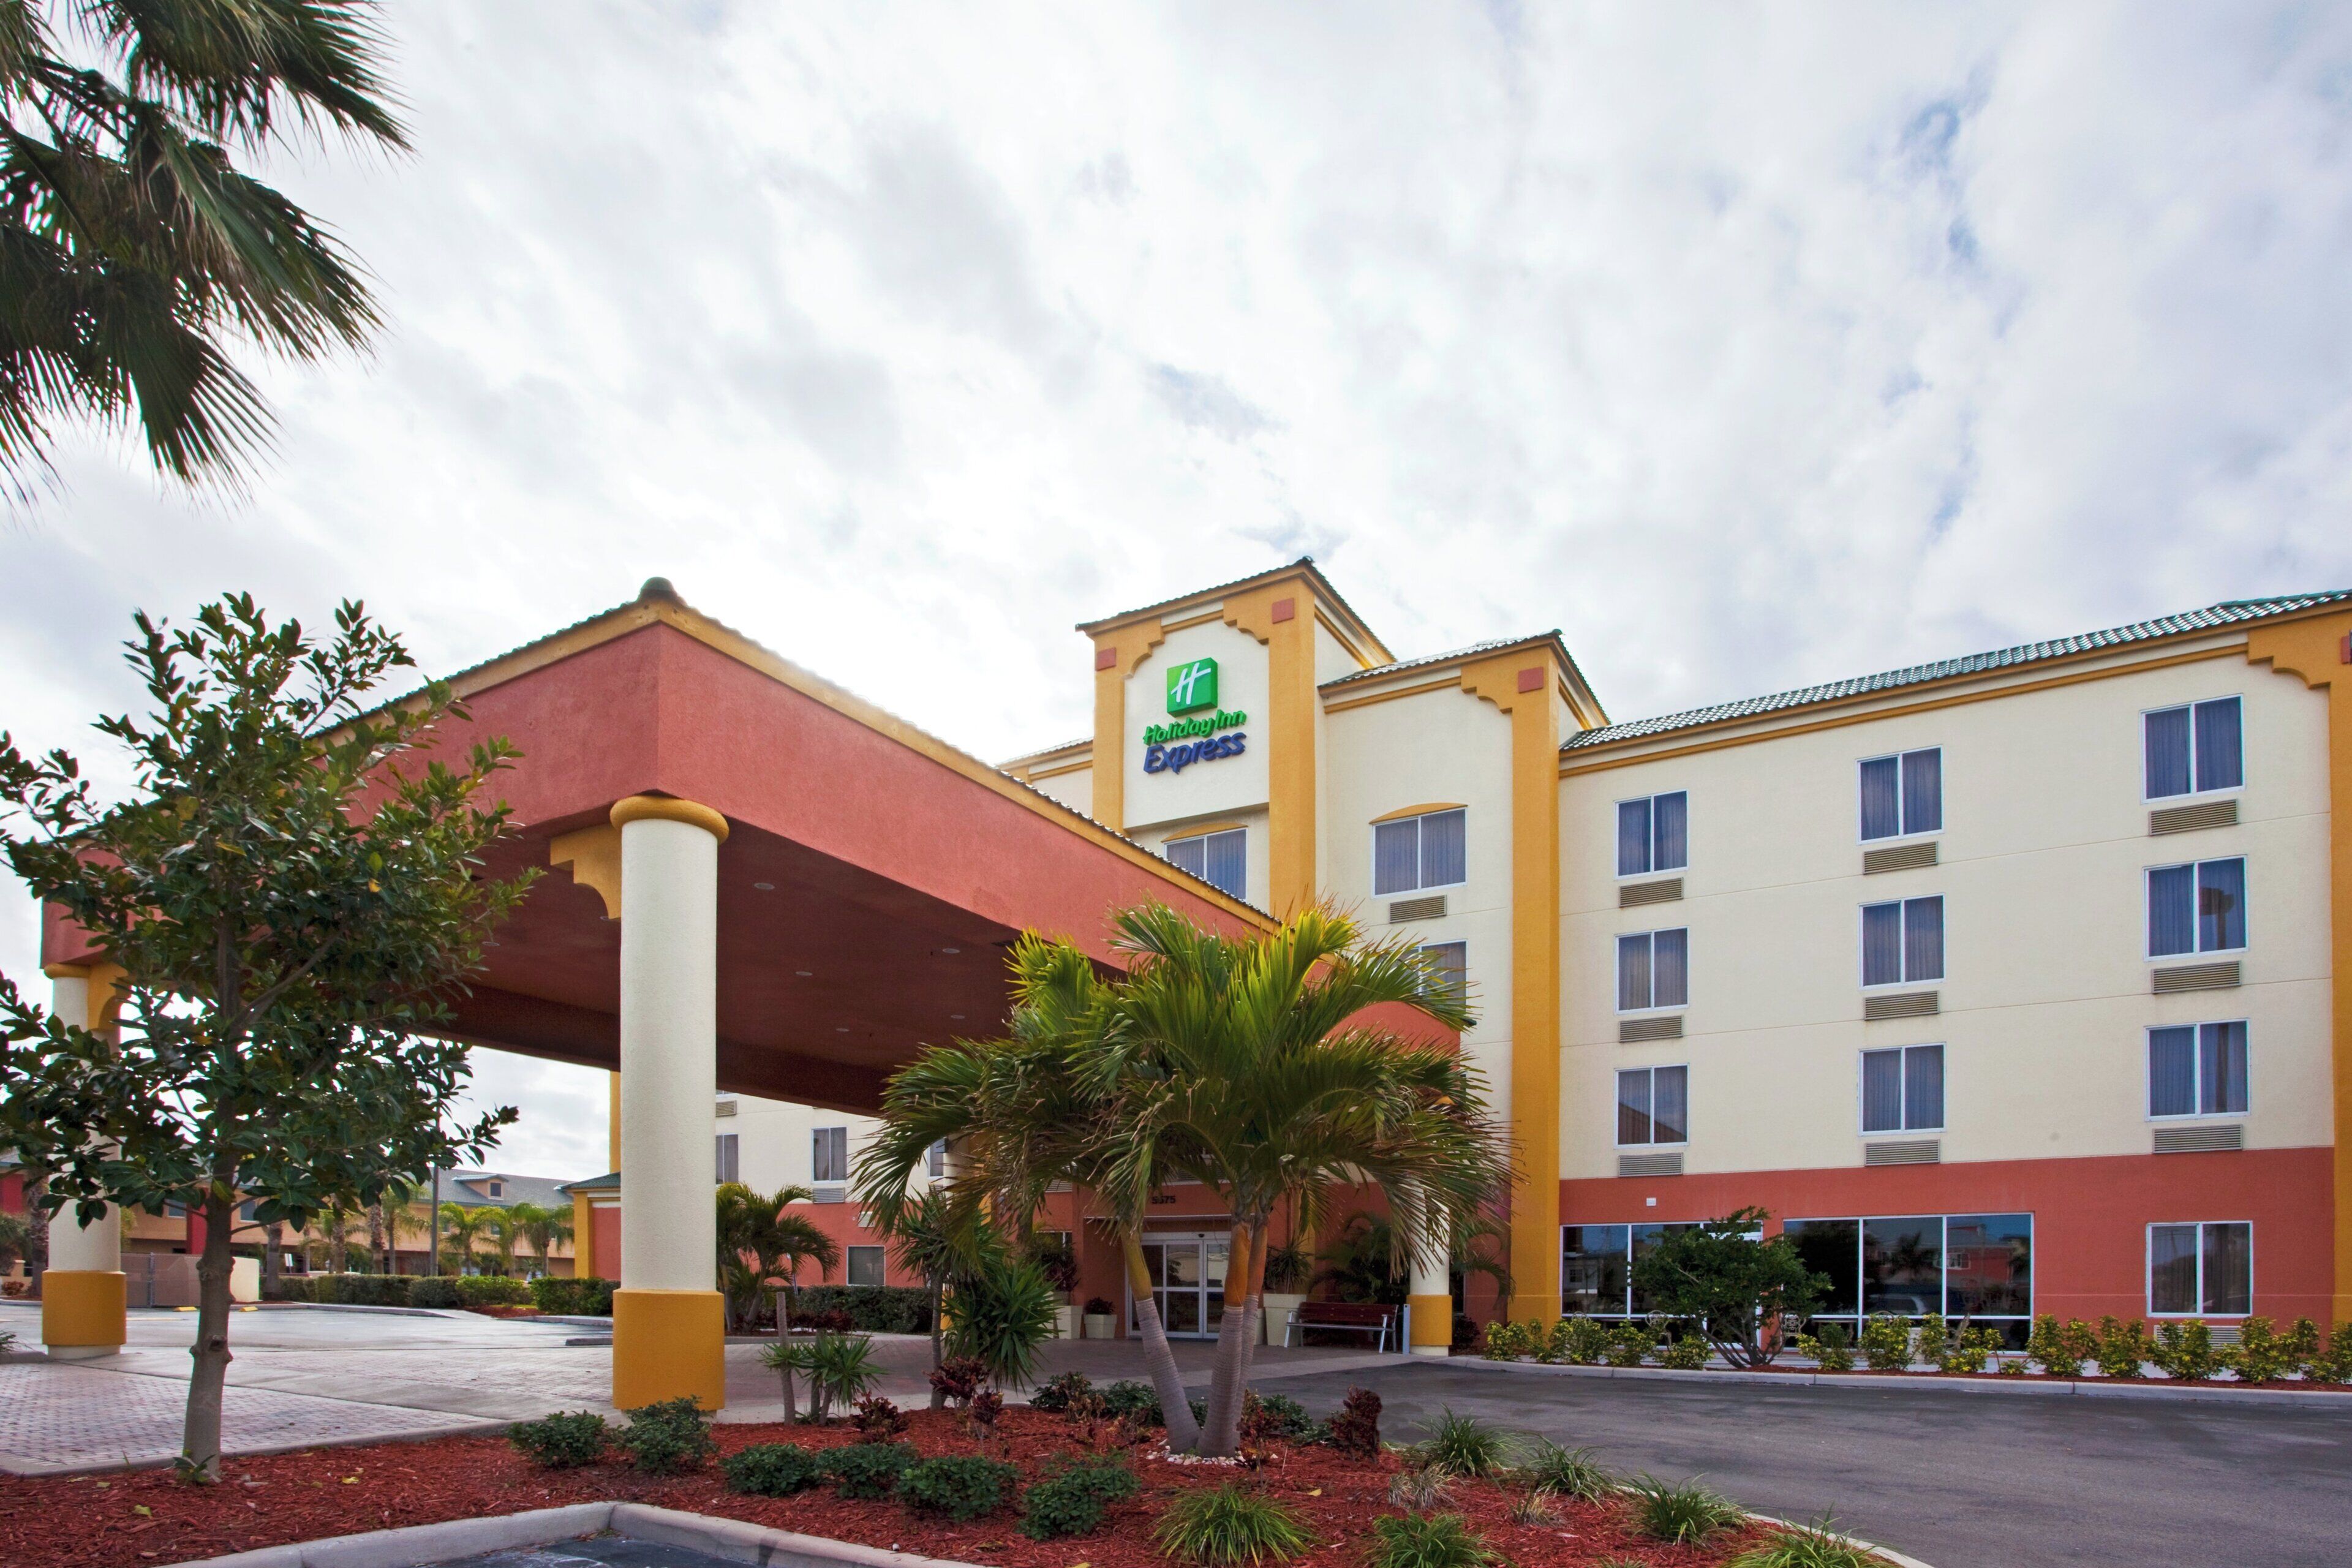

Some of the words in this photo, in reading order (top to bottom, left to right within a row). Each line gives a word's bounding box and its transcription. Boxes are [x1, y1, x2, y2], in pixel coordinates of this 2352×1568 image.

[1143, 717, 1215, 746] Holiday
[1215, 709, 1247, 730] Inn
[1144, 732, 1247, 774] Express
